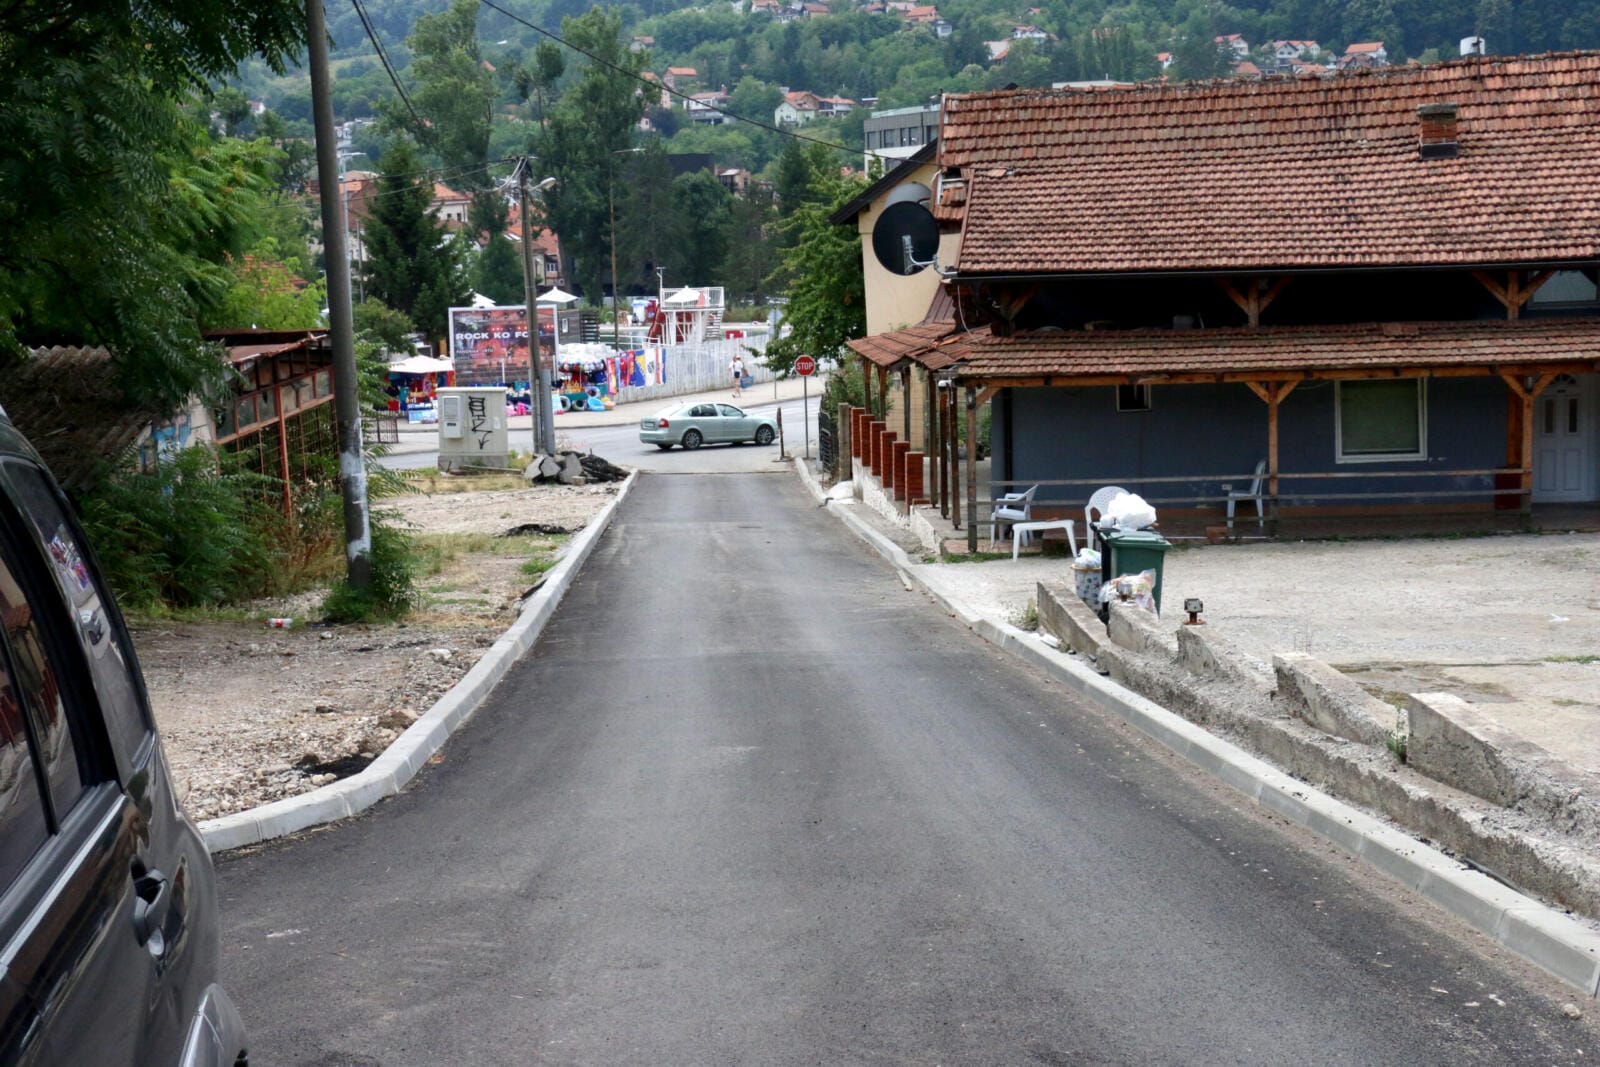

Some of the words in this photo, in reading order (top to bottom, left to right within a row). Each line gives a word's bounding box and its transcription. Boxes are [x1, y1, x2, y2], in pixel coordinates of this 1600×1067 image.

[455, 332, 489, 340] ROCK
[493, 331, 511, 339] KO
[796, 362, 814, 370] STOP
